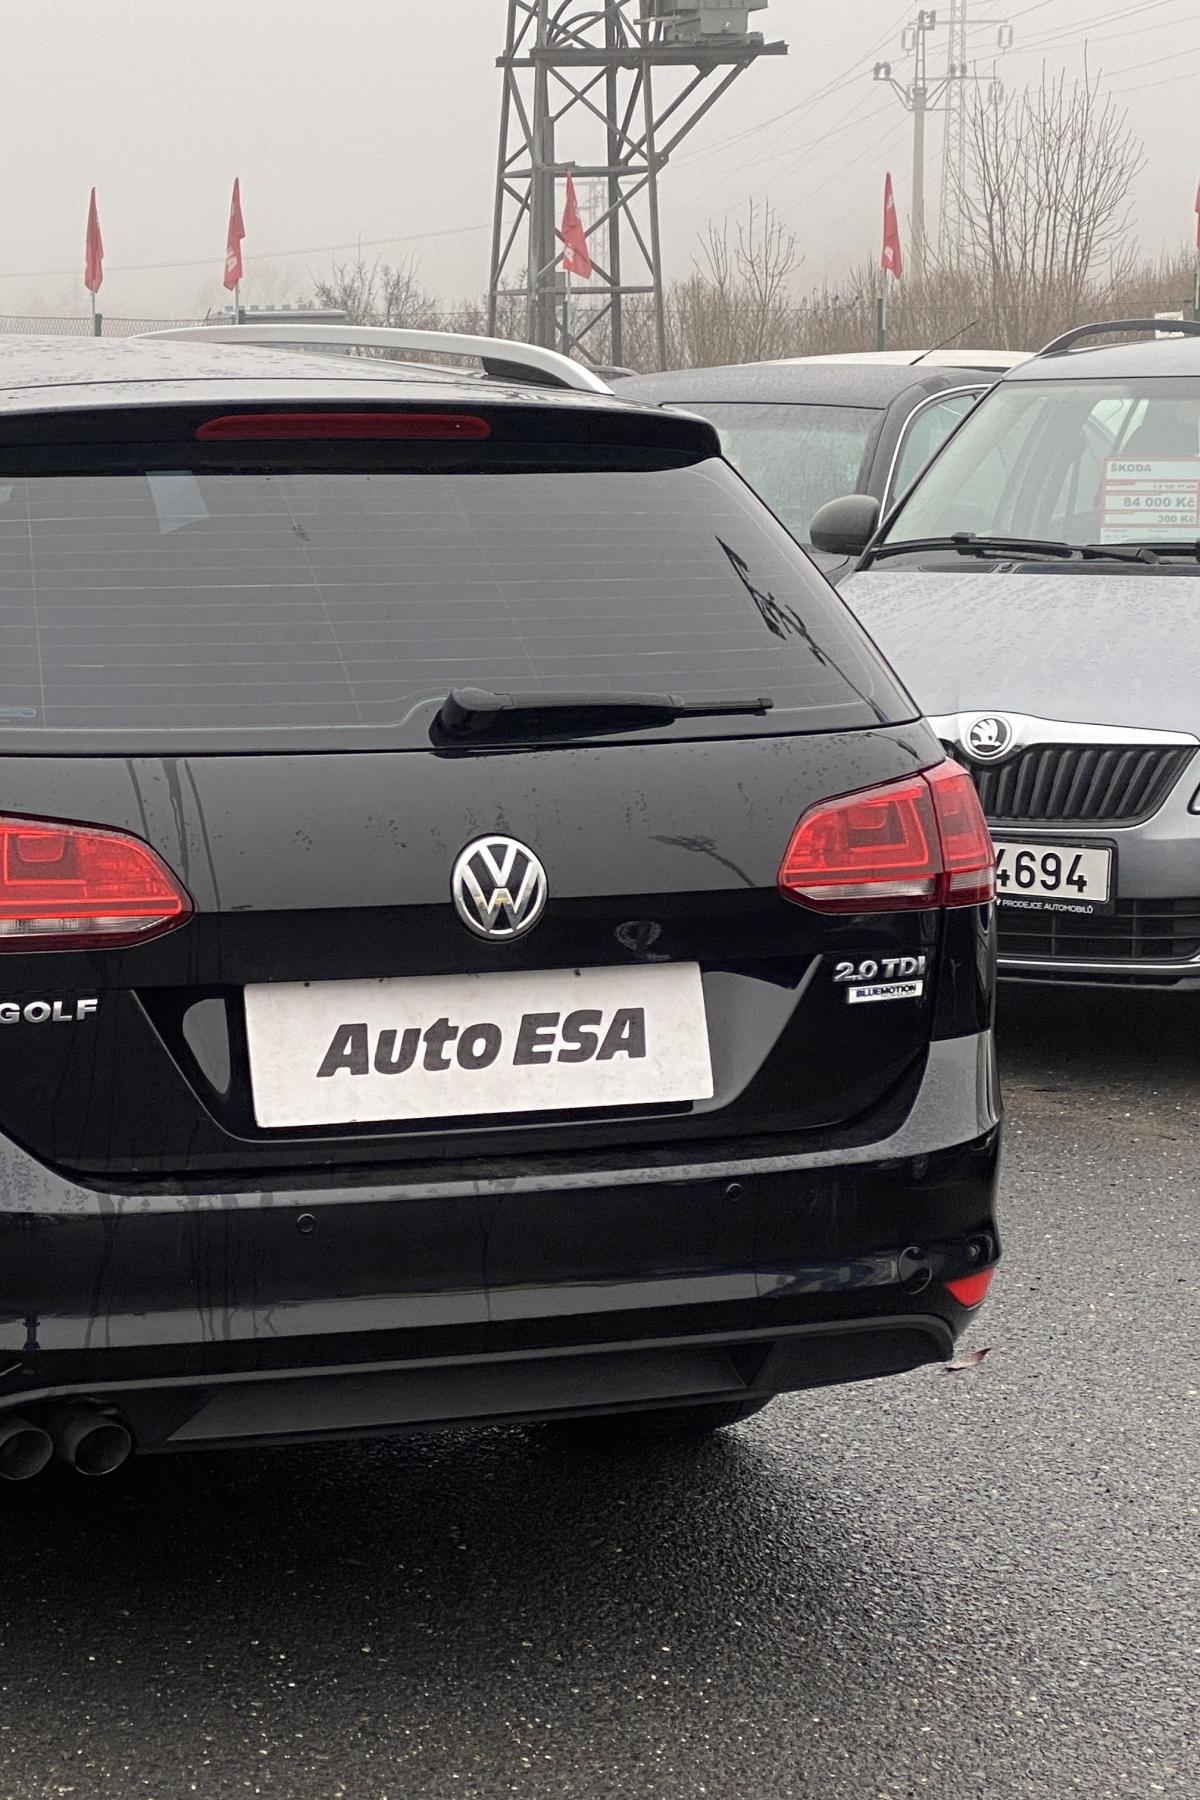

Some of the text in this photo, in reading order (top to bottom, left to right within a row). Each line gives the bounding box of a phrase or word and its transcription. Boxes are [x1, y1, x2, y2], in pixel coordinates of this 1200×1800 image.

[1123, 497, 1196, 508] 84 000 Kč
[996, 848, 1088, 893] 4694
[1002, 899, 1043, 910] PRODEJCE
[1043, 903, 1093, 914] AUTOMOBILŮ
[832, 956, 926, 982] 2.0 TDI
[316, 1007, 647, 1078] Auto ESA
